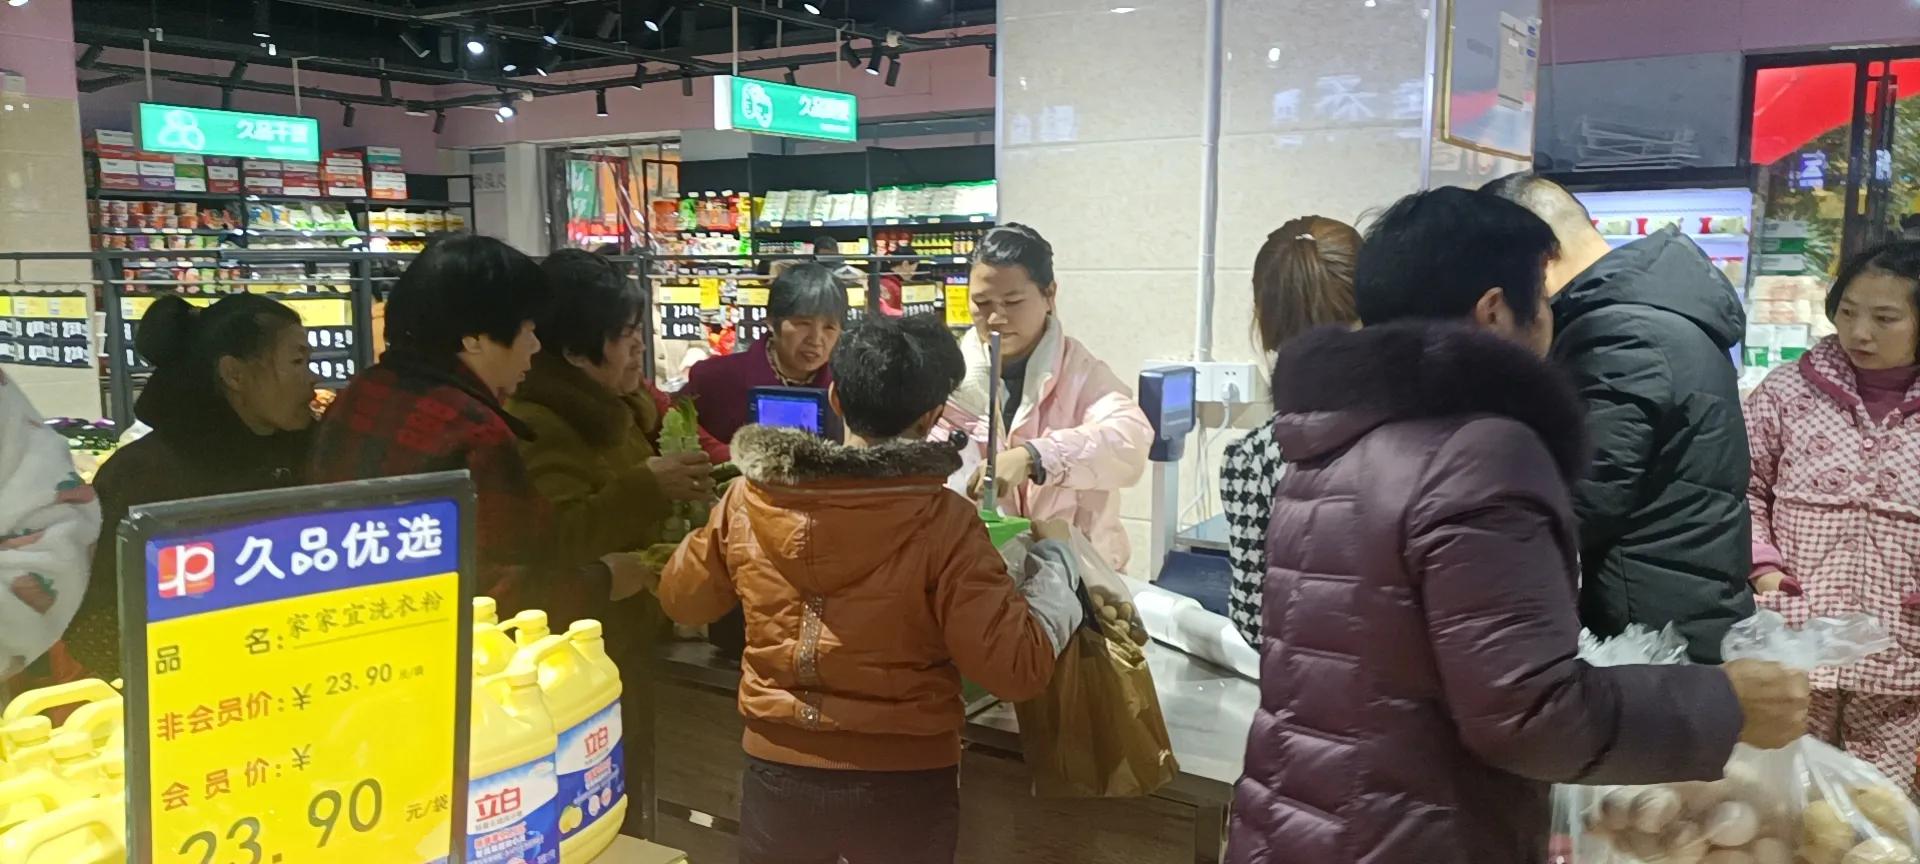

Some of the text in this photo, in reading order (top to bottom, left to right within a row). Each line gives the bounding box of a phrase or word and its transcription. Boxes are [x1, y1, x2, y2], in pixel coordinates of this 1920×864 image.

[234, 513, 442, 586] 久品优选
[325, 663, 392, 695] 23.90
[584, 726, 609, 758] 立白
[475, 787, 521, 822] 立白
